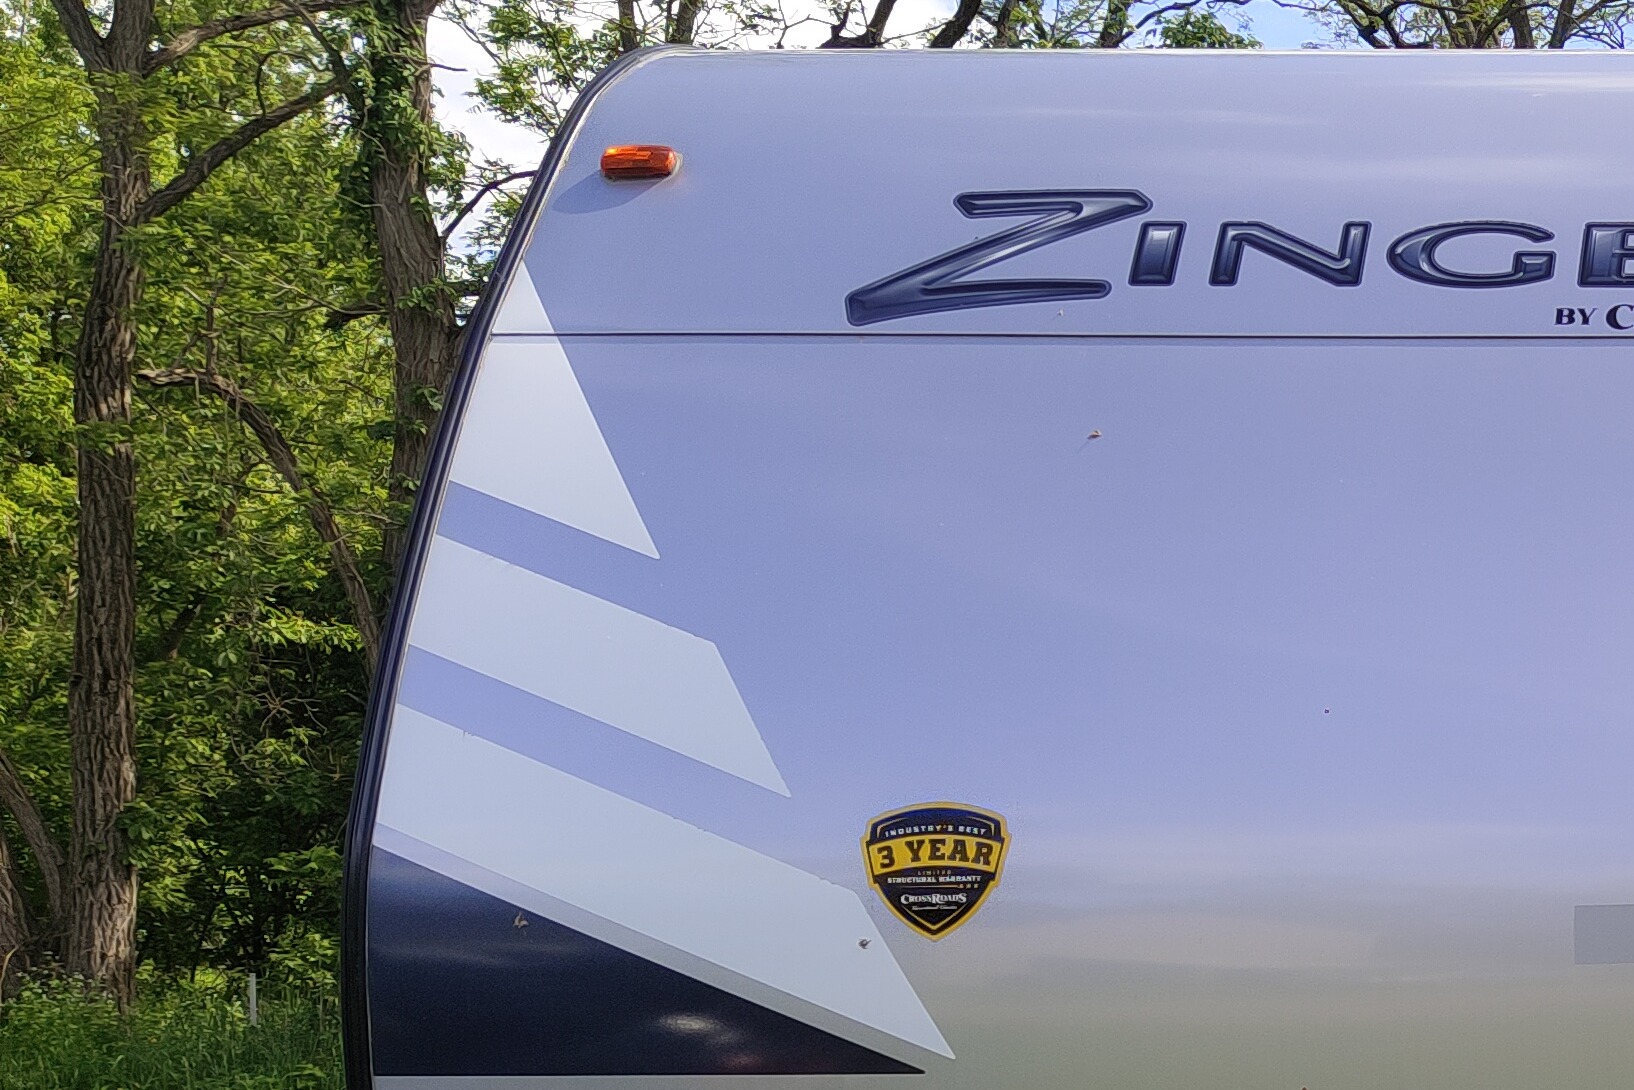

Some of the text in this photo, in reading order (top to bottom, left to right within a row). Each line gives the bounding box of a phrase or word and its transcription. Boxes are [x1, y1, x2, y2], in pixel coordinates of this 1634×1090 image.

[1554, 307, 1599, 326] BY
[884, 825, 987, 838] INDUSTRY'S BEST
[876, 838, 994, 869] 3 YEAR
[887, 875, 982, 884] STRUCTURAL WARRANTY
